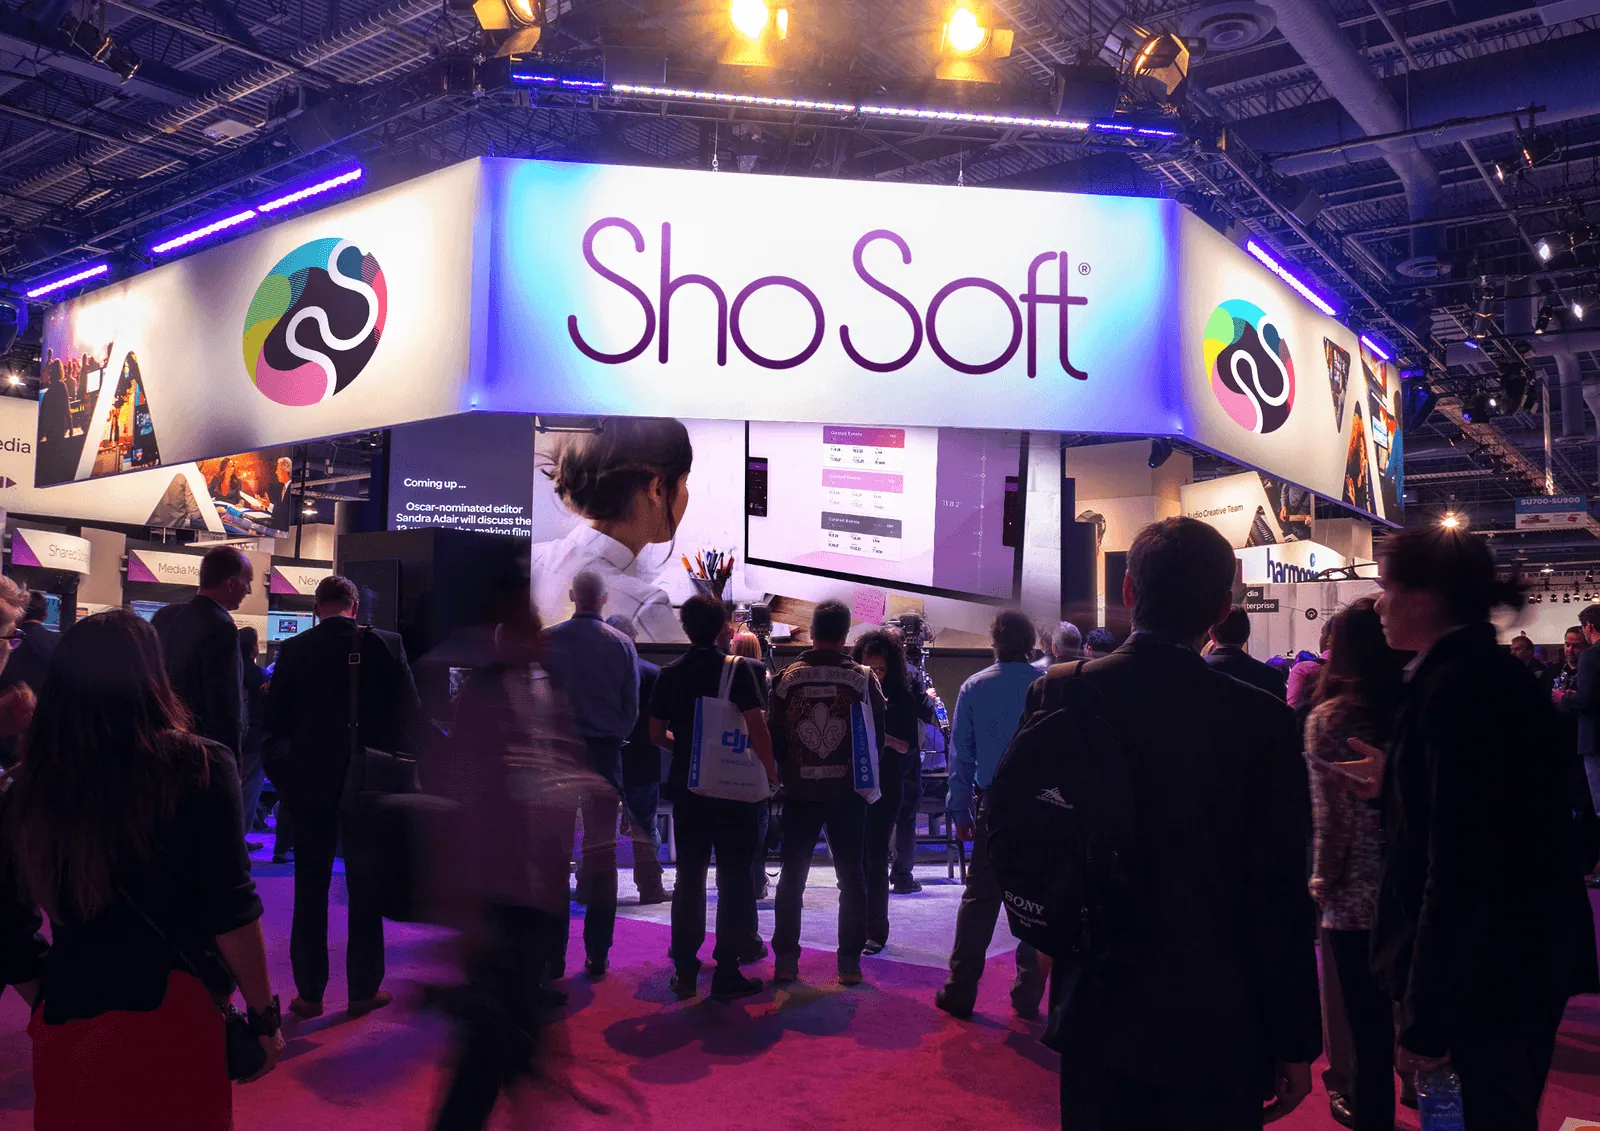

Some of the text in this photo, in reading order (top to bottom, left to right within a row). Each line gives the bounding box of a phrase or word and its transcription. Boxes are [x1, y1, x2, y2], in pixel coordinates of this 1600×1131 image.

[567, 216, 825, 369] Sho
[0, 437, 31, 453] dia
[404, 478, 443, 490] Coming
[444, 480, 457, 490] up
[406, 502, 523, 514] Oscar-nominated editor
[1521, 497, 1580, 506] SU700-SU900
[1203, 507, 1226, 518] Creative
[1227, 504, 1243, 514] Team
[396, 513, 531, 526] Sandra Adair will discuss the
[158, 562, 199, 576] Media Ma
[1246, 590, 1259, 598] dia
[1246, 602, 1275, 611] terprise
[1004, 890, 1044, 915] SONY
